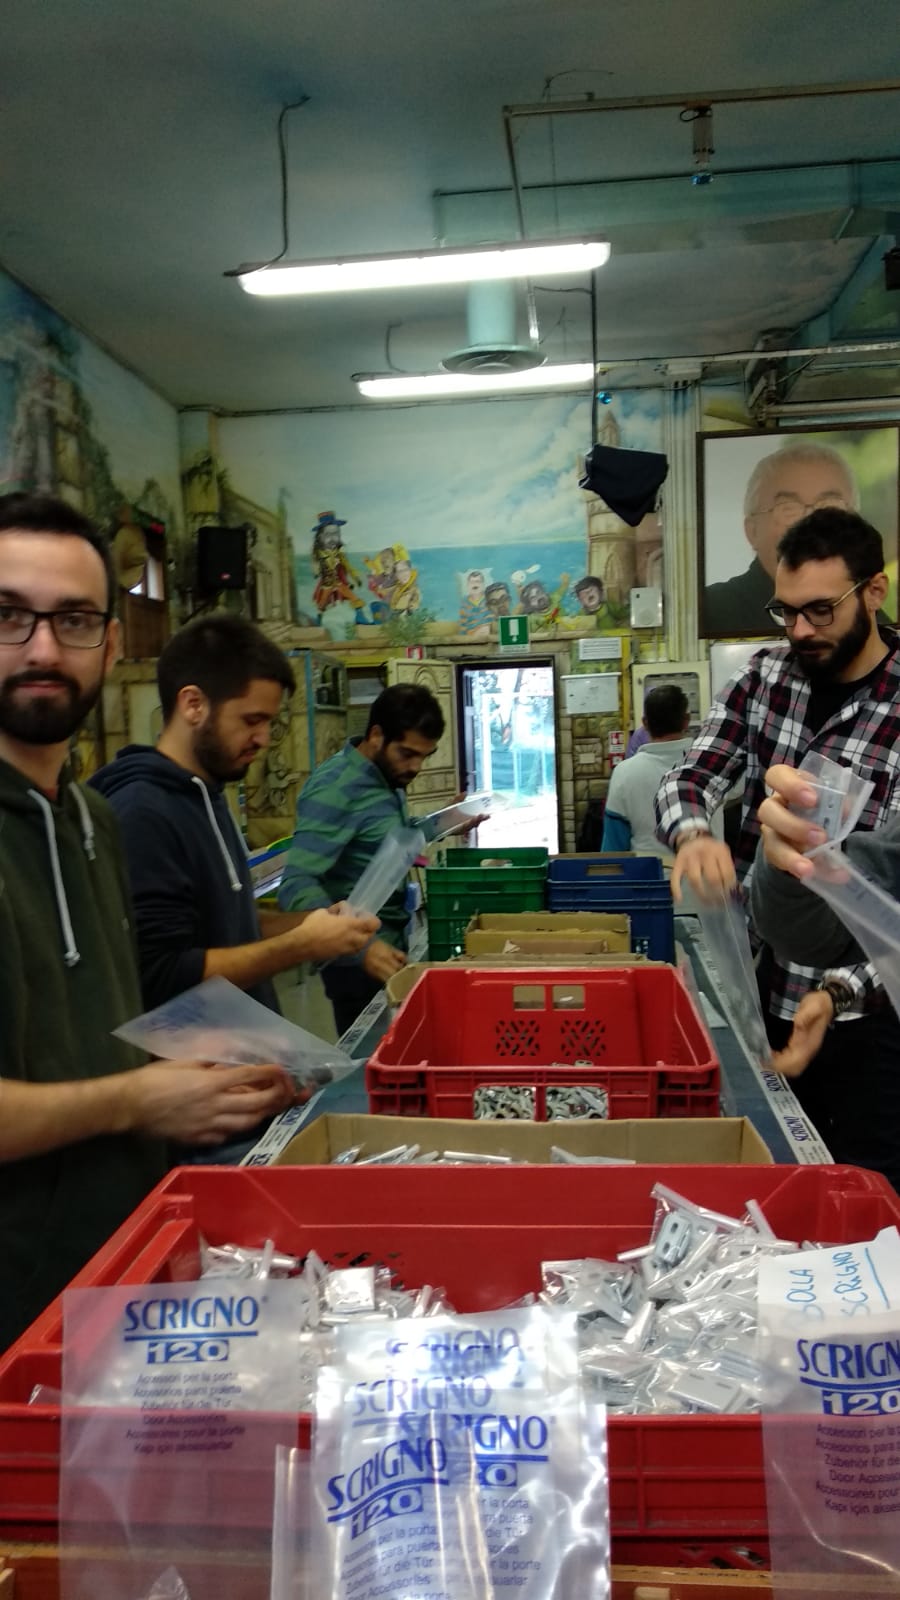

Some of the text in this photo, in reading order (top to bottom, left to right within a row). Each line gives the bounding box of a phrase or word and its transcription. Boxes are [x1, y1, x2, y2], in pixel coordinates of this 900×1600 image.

[124, 1296, 259, 1332] SCRIGNO
[148, 1340, 229, 1364] 120
[327, 1437, 447, 1511] SCRIGNO
[829, 1467, 855, 1483] Door
[352, 1486, 424, 1540] 120
[408, 1523, 437, 1538] porta
